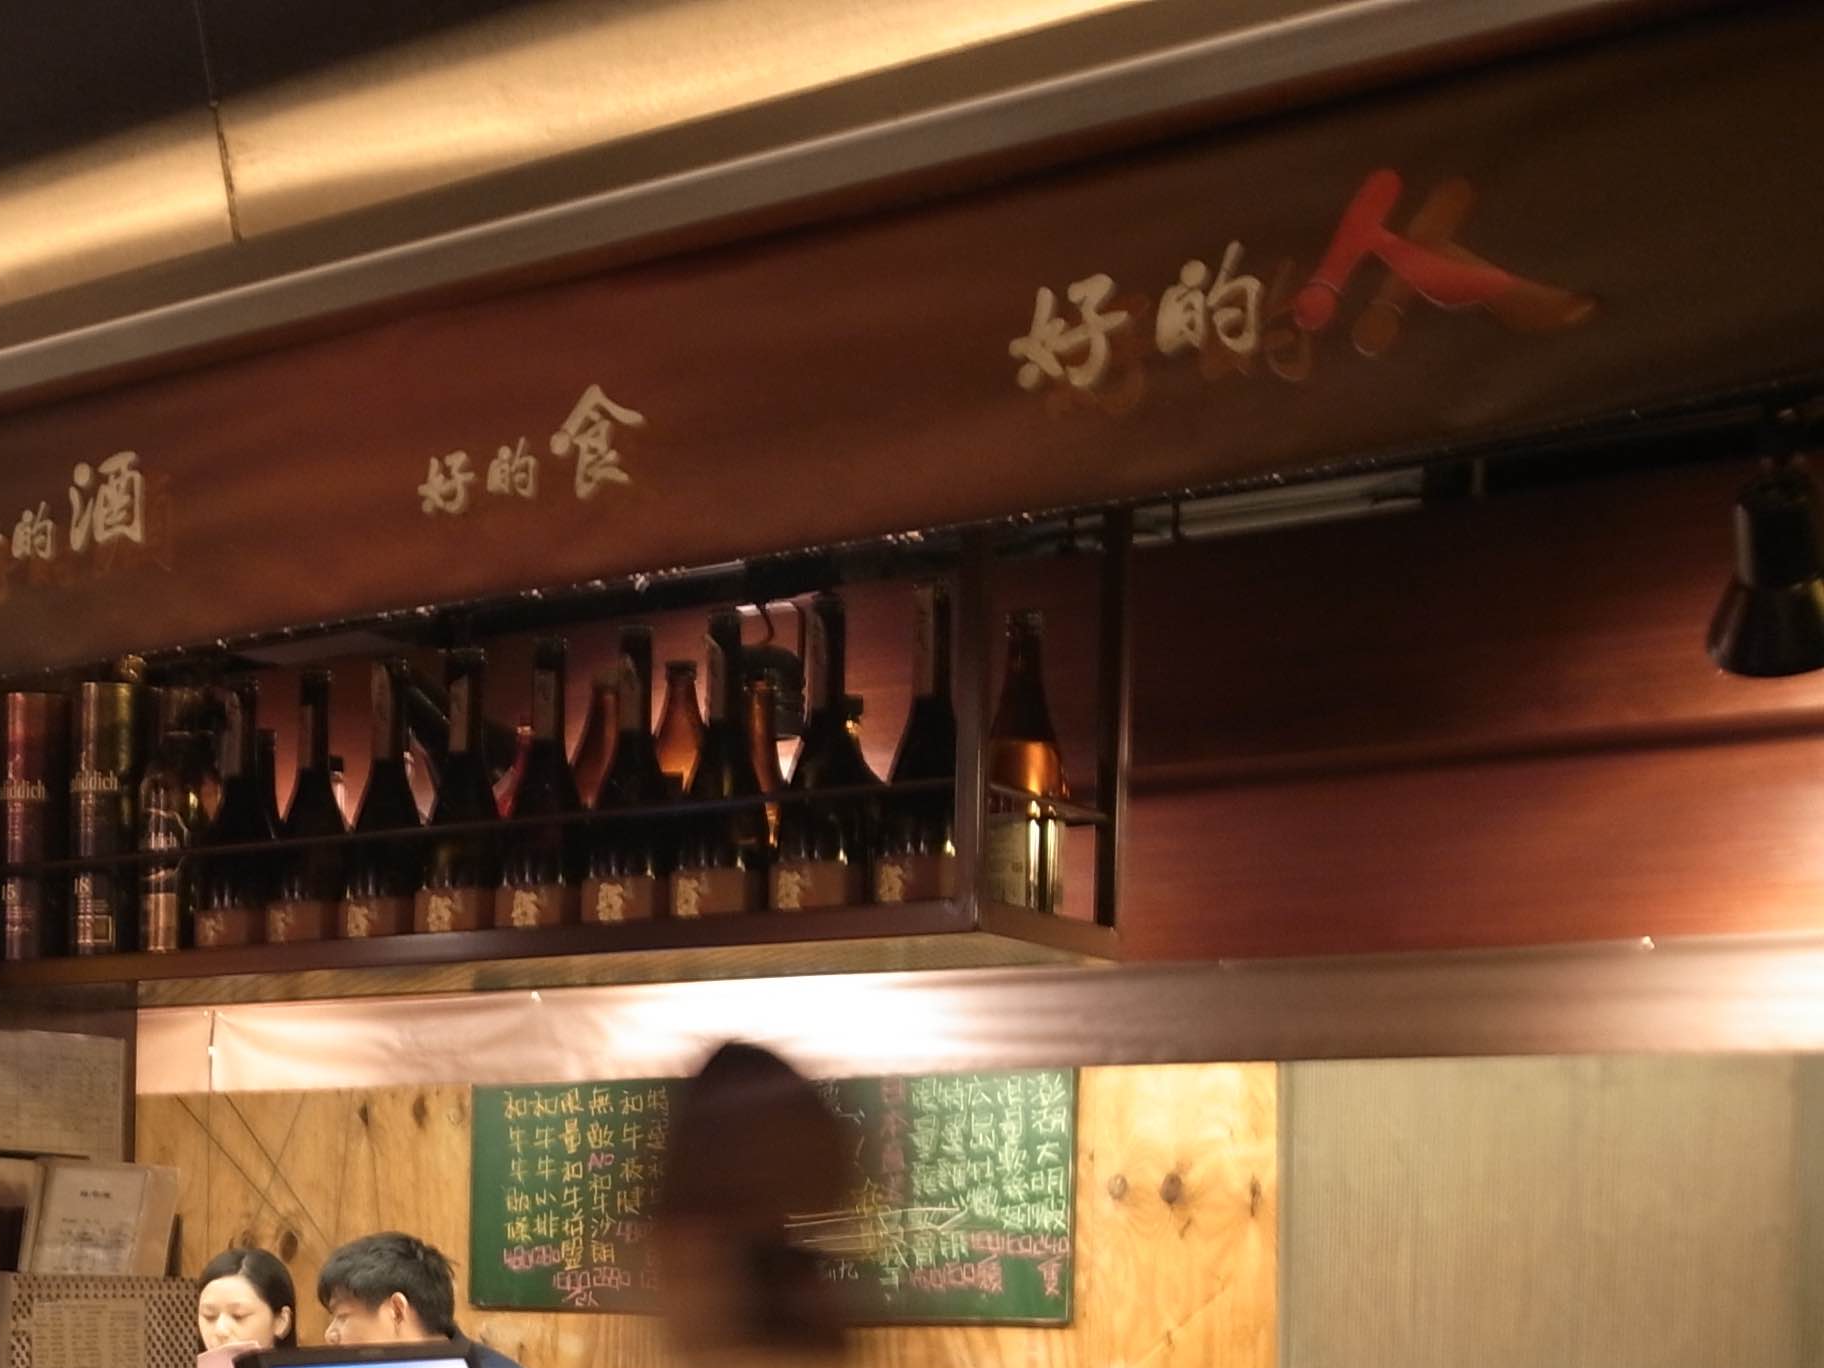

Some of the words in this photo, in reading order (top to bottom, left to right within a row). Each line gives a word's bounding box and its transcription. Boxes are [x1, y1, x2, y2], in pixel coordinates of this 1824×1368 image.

[1008, 170, 1600, 391] 好的人
[419, 384, 645, 515] 好的食
